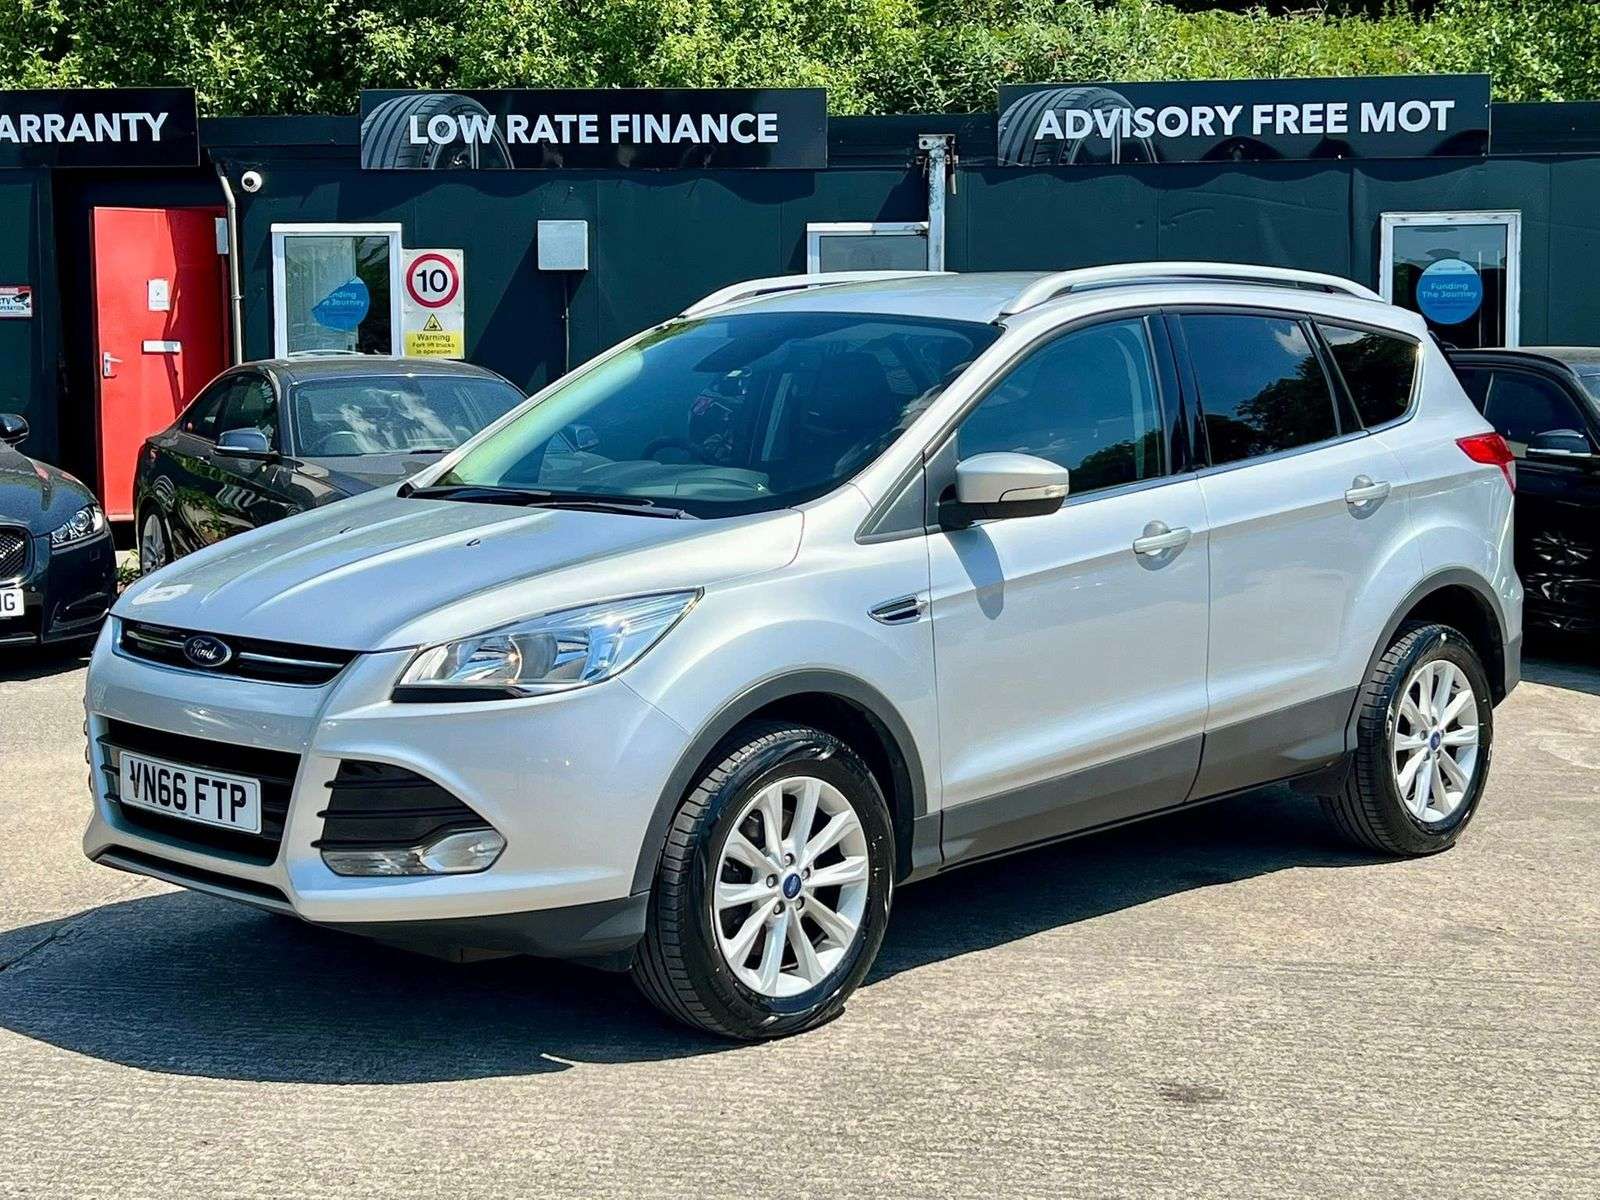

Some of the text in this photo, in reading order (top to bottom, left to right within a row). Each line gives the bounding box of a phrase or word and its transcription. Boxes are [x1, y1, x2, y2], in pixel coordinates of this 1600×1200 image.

[409, 112, 779, 145] LOW RATE FINANCE
[1034, 99, 1456, 140] ADVISORY FREE MOT
[416, 269, 449, 293] 10
[1431, 282, 1469, 291] Funding
[331, 298, 365, 307] Journey
[1440, 290, 1478, 299] Journey
[416, 333, 451, 343] Warning
[190, 639, 218, 660] Ford
[129, 760, 247, 822] VN66 FTP
